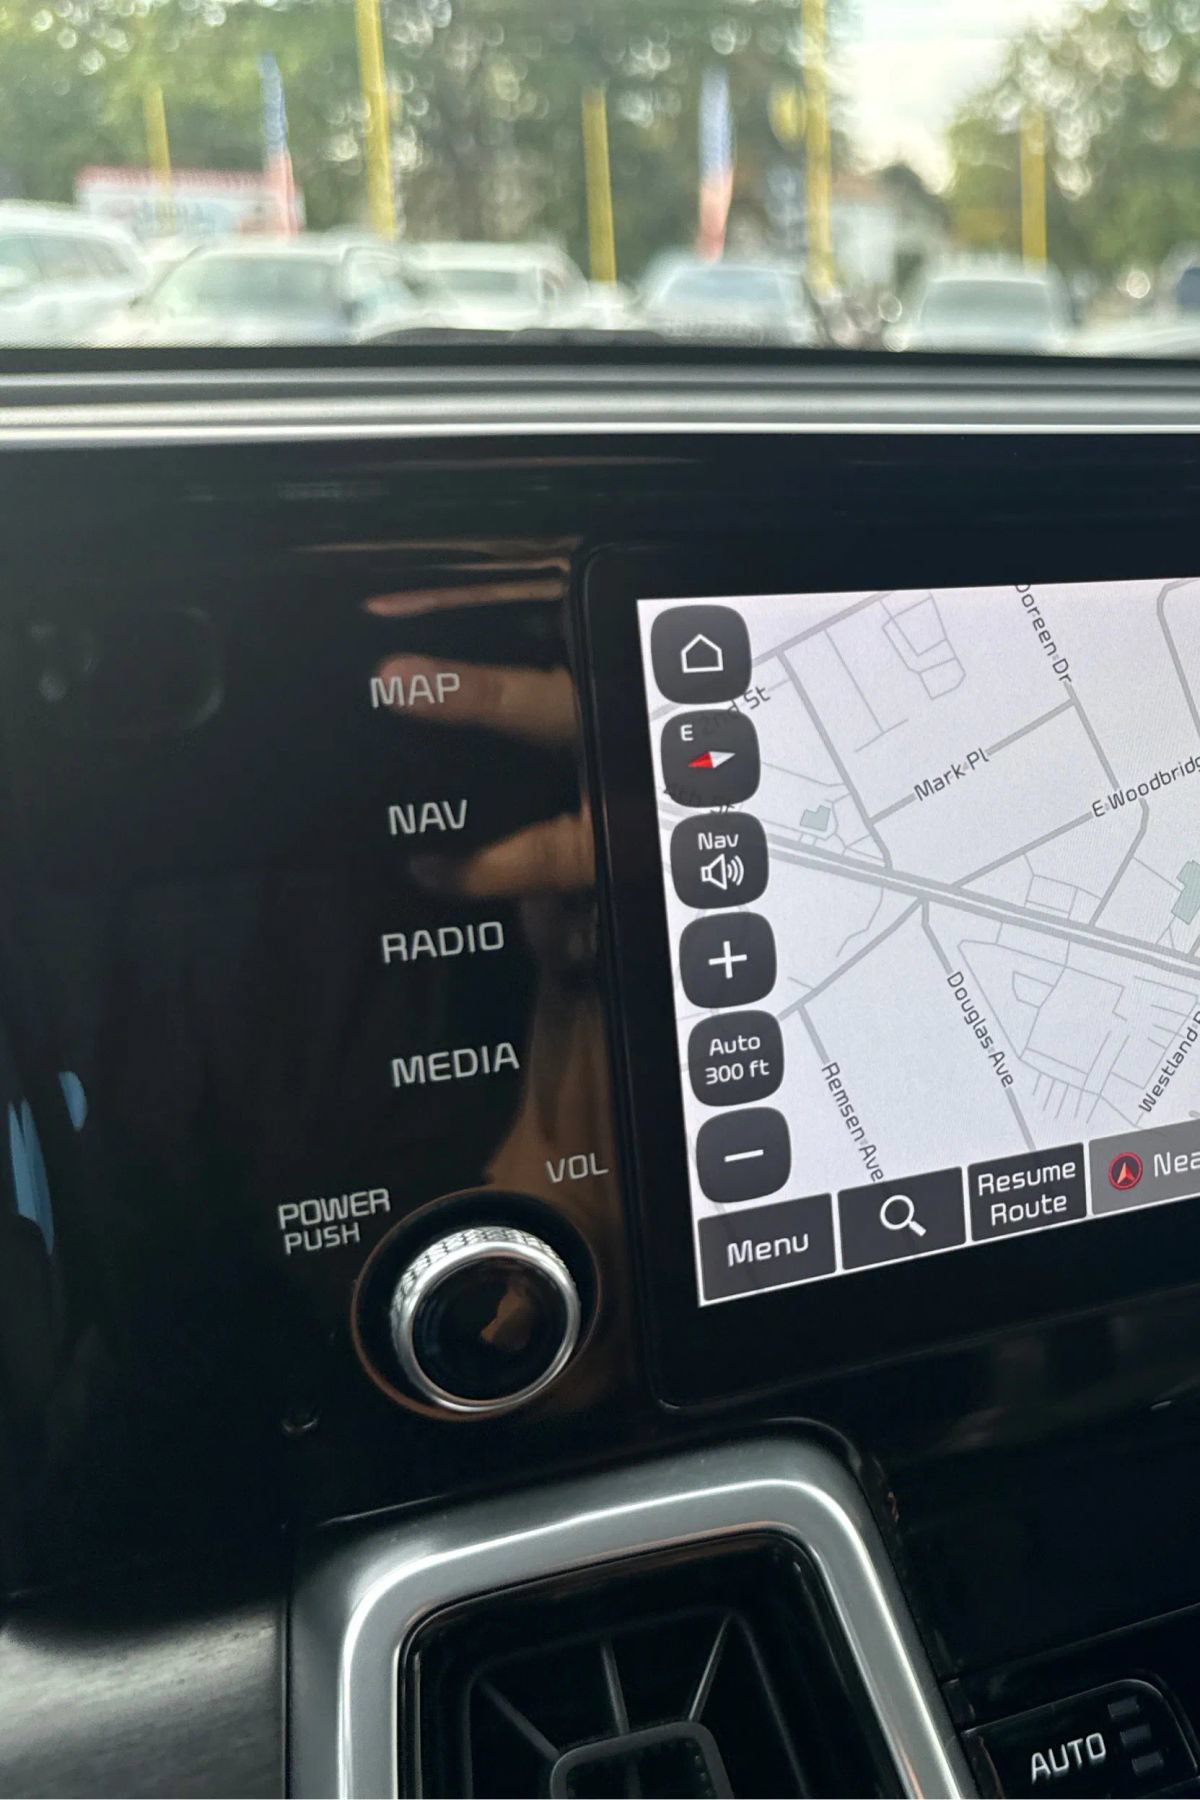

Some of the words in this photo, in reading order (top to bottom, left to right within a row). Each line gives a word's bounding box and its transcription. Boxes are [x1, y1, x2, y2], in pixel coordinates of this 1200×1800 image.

[1051, 657, 1072, 686] Dr
[369, 672, 461, 708] MAP
[744, 686, 771, 710] St
[680, 724, 694, 742] E
[914, 765, 966, 801] Mark
[967, 747, 990, 771] Pl
[388, 799, 468, 836] NAV
[1092, 799, 1105, 818] E
[698, 831, 739, 849] Nav
[381, 921, 505, 964] RADIO
[709, 1033, 761, 1056] Auto
[946, 970, 994, 1052] Douglas
[989, 1050, 1015, 1088] Ave
[391, 1041, 520, 1088] MEDIA
[705, 1063, 745, 1085] 300
[748, 1060, 769, 1079] ft
[1138, 1023, 1200, 1113] Westland
[822, 1062, 866, 1144] Remsen
[860, 1141, 885, 1183] Ave
[546, 1152, 609, 1183] VOL
[977, 1160, 1077, 1196] Resume
[277, 1188, 391, 1230] POWER
[990, 1193, 1068, 1227] Route
[283, 1223, 361, 1255] PUSH
[727, 1230, 809, 1267] Menu
[1031, 1732, 1107, 1785] AUTO
